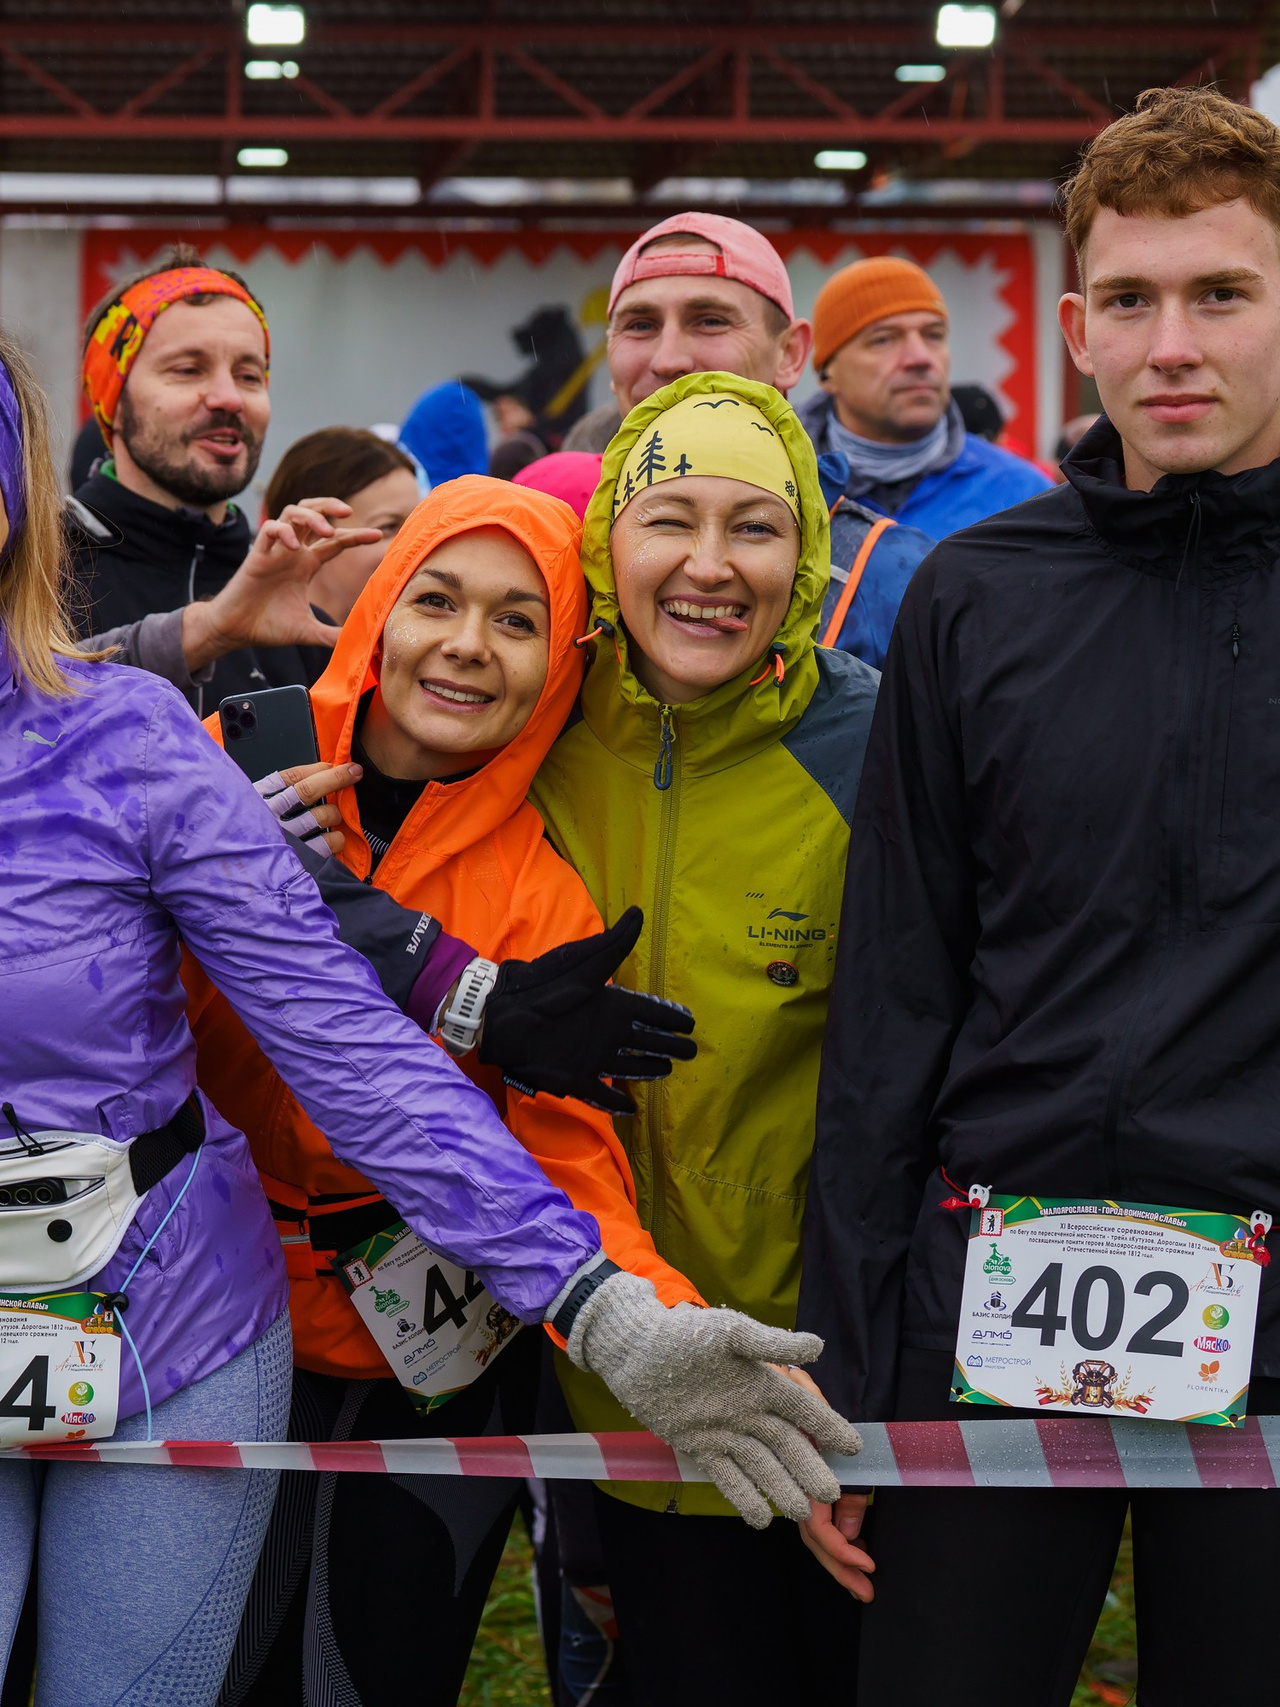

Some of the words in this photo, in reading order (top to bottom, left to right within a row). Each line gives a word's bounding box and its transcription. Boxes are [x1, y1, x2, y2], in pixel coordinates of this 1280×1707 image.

[748, 926, 826, 941] LI-NING
[1040, 1205, 1097, 1216] «МАЛОЯРОСЛАВЕЦ
[1102, 1207, 1123, 1216] ГОРОД
[1124, 1208, 1159, 1221] ВОИНСКОЙ
[1159, 1214, 1187, 1227] СЛАВЫ»
[1067, 1223, 1115, 1232] Всероссийские
[1117, 1227, 1164, 1237] соревнования
[1018, 1228, 1029, 1236] бегу
[1157, 1238, 1186, 1248] Дорогами
[1188, 1242, 1201, 1250] 1812
[1029, 1237, 1064, 1245] посвященные
[1106, 1241, 1164, 1252] Малоярославецкого
[1165, 1247, 1194, 1256] сражения
[1066, 1245, 1108, 1254] Отечественной
[384, 1261, 395, 1269] бегу
[983, 1263, 1011, 1272] bionova
[22, 1301, 49, 1310] СЛАВЫ»
[375, 1295, 401, 1311] bionova
[991, 1312, 1012, 1320] ХОЛДИ
[1011, 1262, 1190, 1358] 402
[392, 1338, 408, 1350] БАЗИС
[426, 1344, 462, 1372] МЕТРОСТРОЙ
[985, 1356, 1031, 1366] МЕТРОСТРОЙ
[1187, 1384, 1229, 1394] FLORENTIKA
